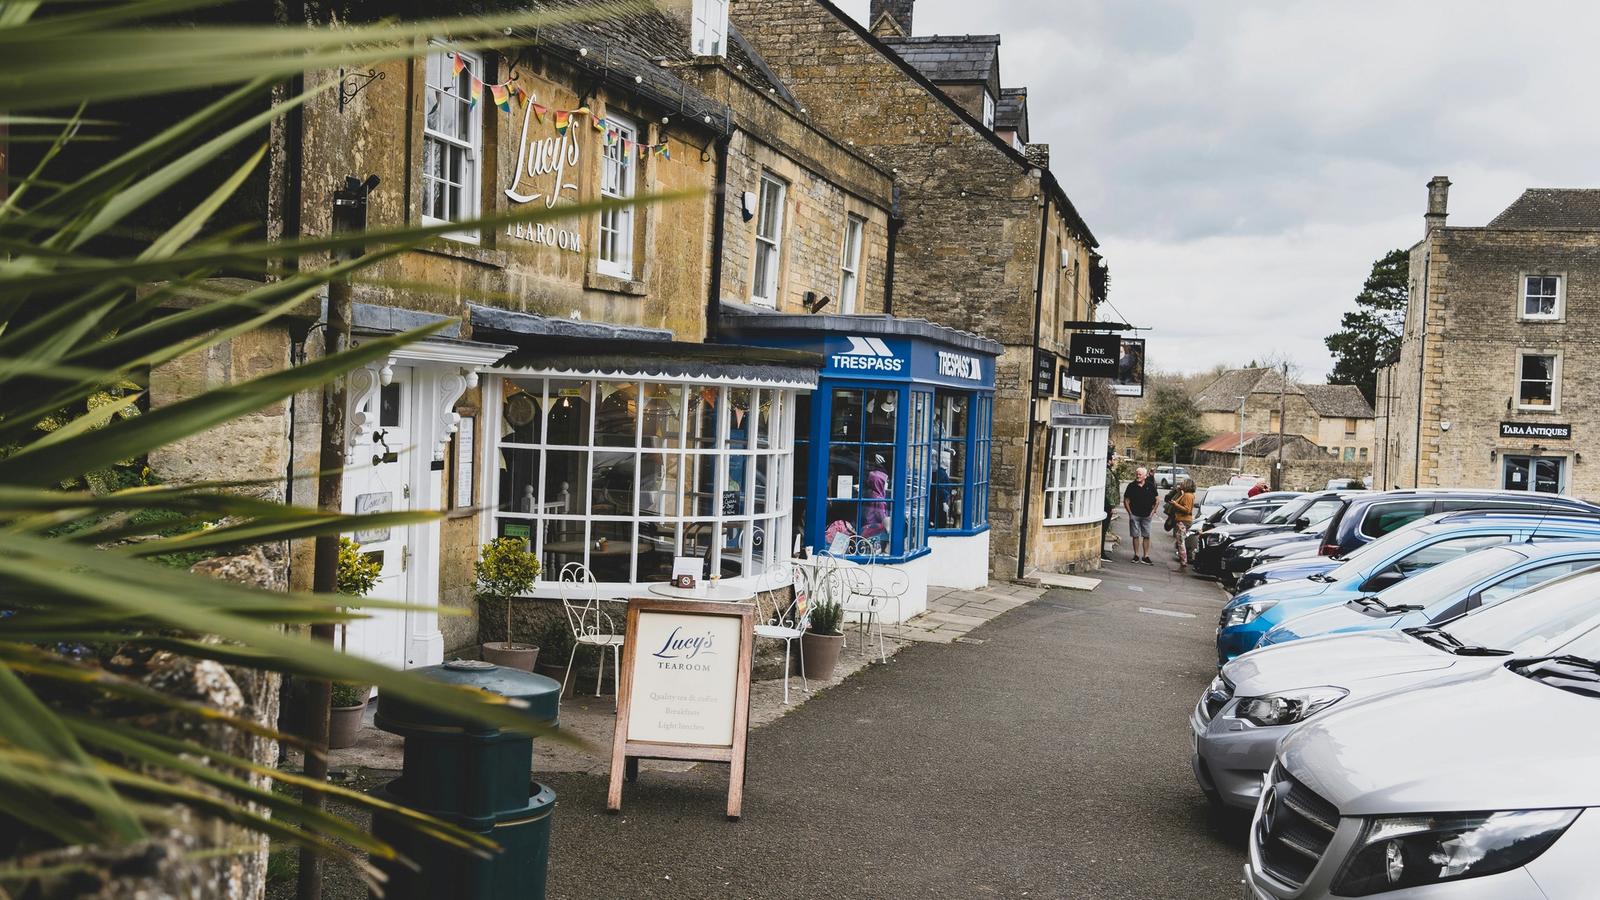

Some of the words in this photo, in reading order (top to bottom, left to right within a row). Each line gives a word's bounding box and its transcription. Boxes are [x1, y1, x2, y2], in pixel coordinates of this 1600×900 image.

[504, 94, 579, 208] Lucy's
[505, 219, 581, 253] TEAROOM
[1085, 345, 1105, 355] FINE
[832, 355, 902, 371] TRESPASS
[938, 351, 970, 378] TRESPASS
[1075, 355, 1114, 364] PAINTINGS
[1503, 425, 1524, 434] TARA
[1526, 426, 1568, 436] ANTIQUES
[652, 626, 716, 660] Lucy's
[658, 662, 711, 671] TEAROOM
[649, 692, 676, 702] Quality
